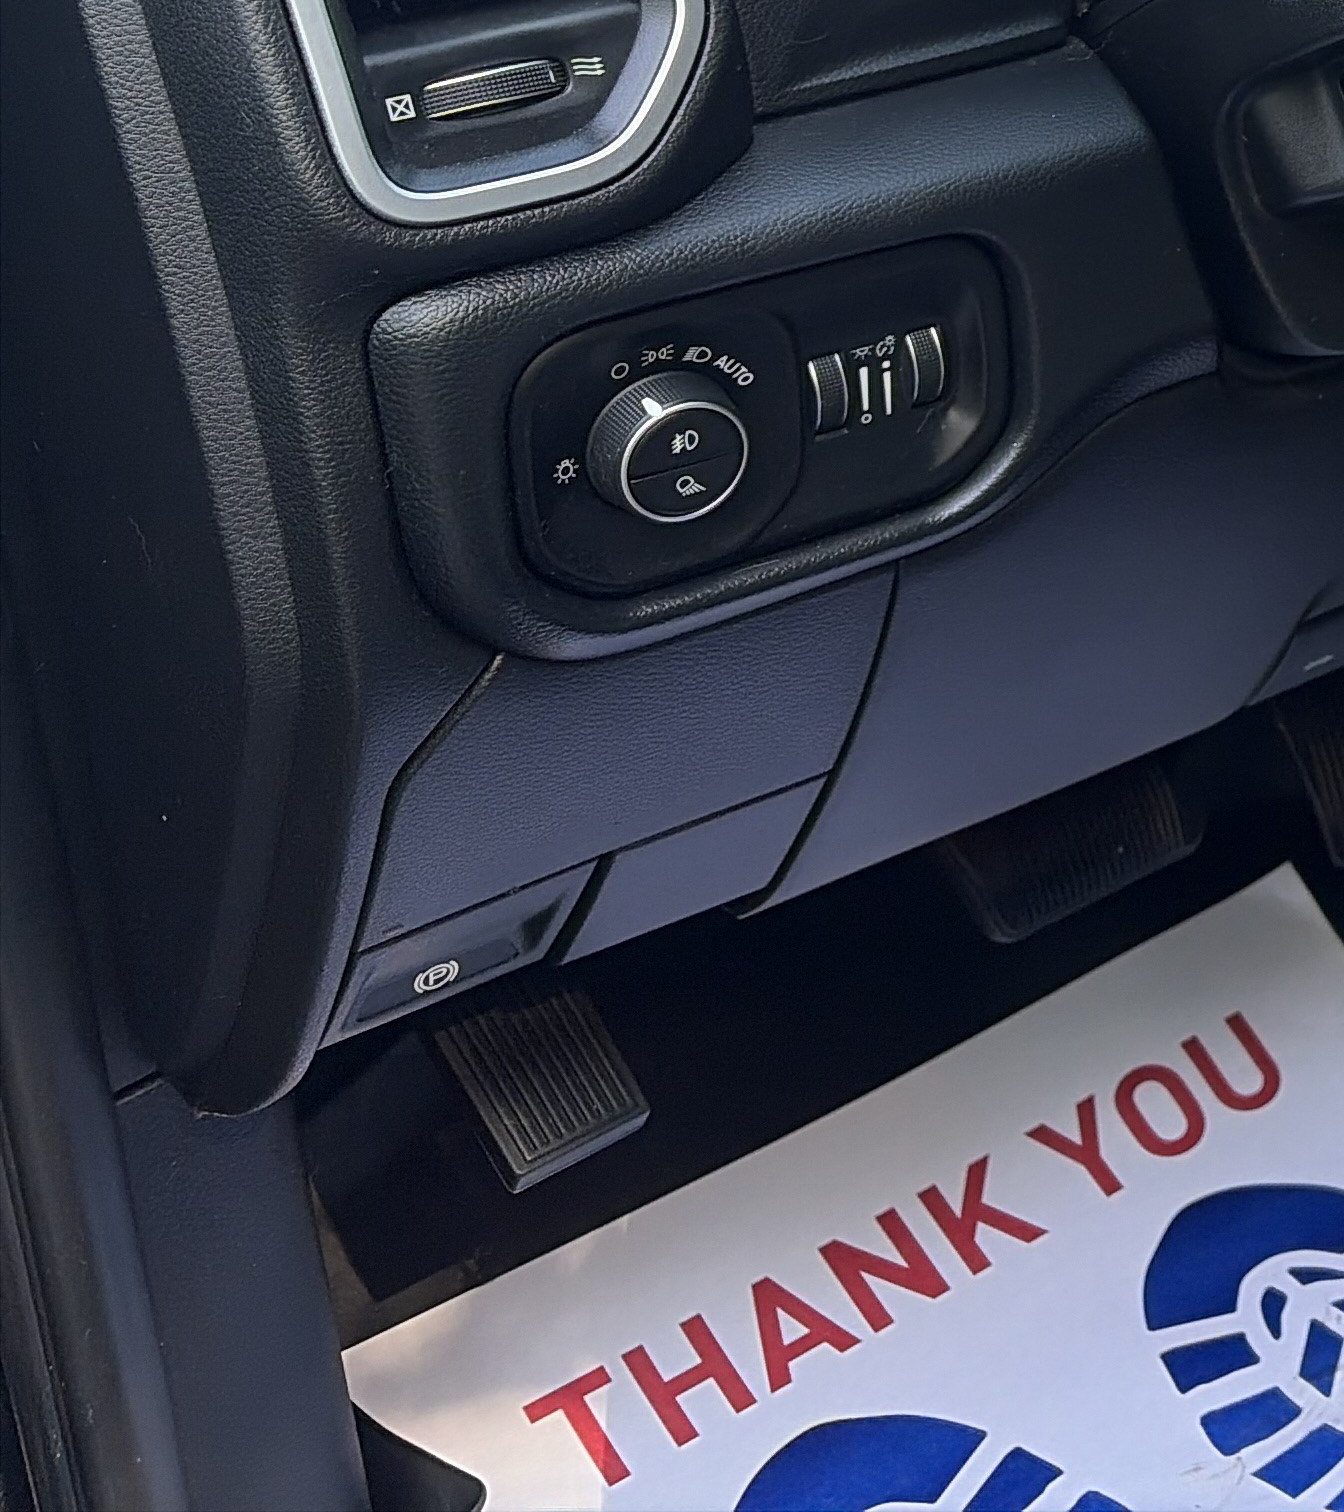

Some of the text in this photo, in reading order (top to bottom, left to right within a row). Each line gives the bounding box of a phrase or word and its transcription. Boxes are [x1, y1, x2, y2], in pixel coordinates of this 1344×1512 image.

[712, 355, 755, 386] AUTO
[522, 1011, 1283, 1488] THANK YOU
